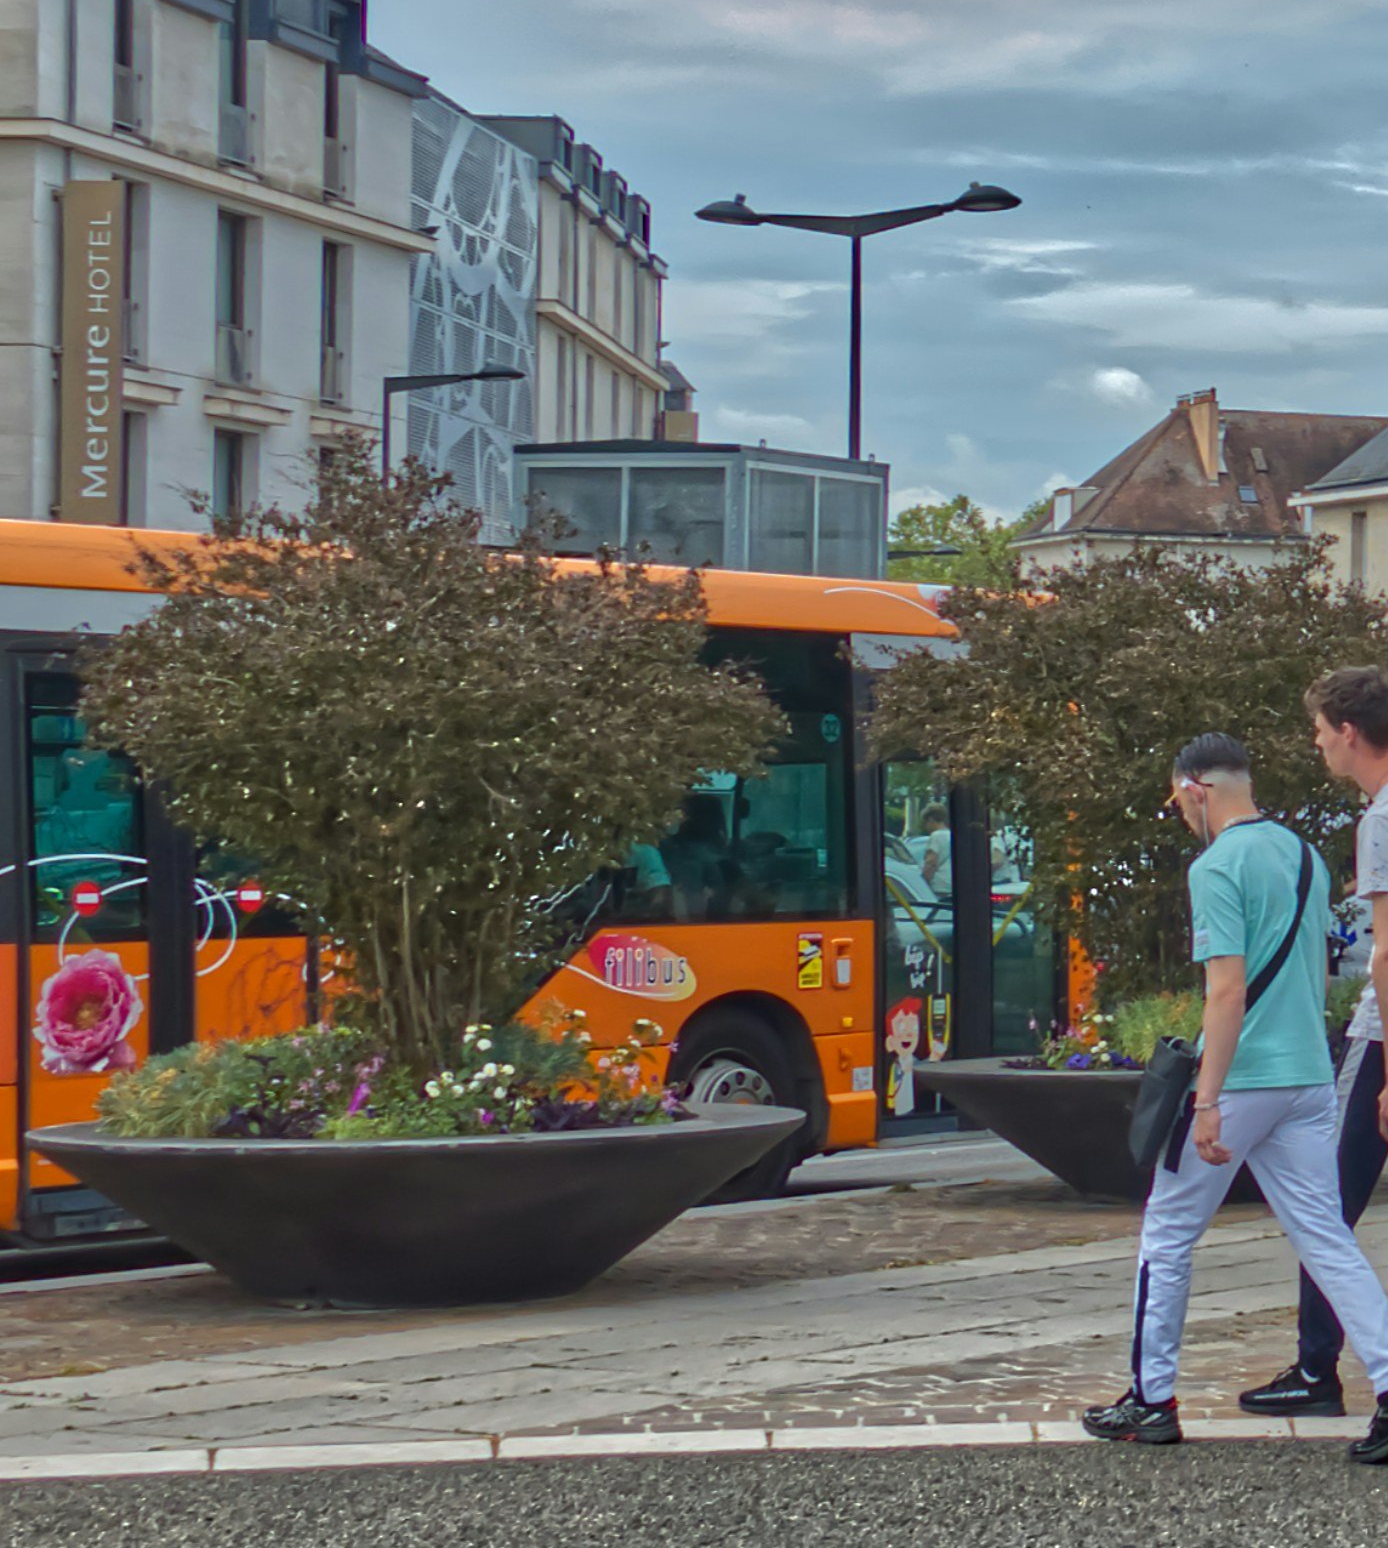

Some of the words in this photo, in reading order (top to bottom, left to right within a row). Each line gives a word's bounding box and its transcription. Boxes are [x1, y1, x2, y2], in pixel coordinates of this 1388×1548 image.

[88, 210, 112, 313] HOTEL
[81, 325, 110, 498] Mercure
[604, 946, 687, 988] filibus
